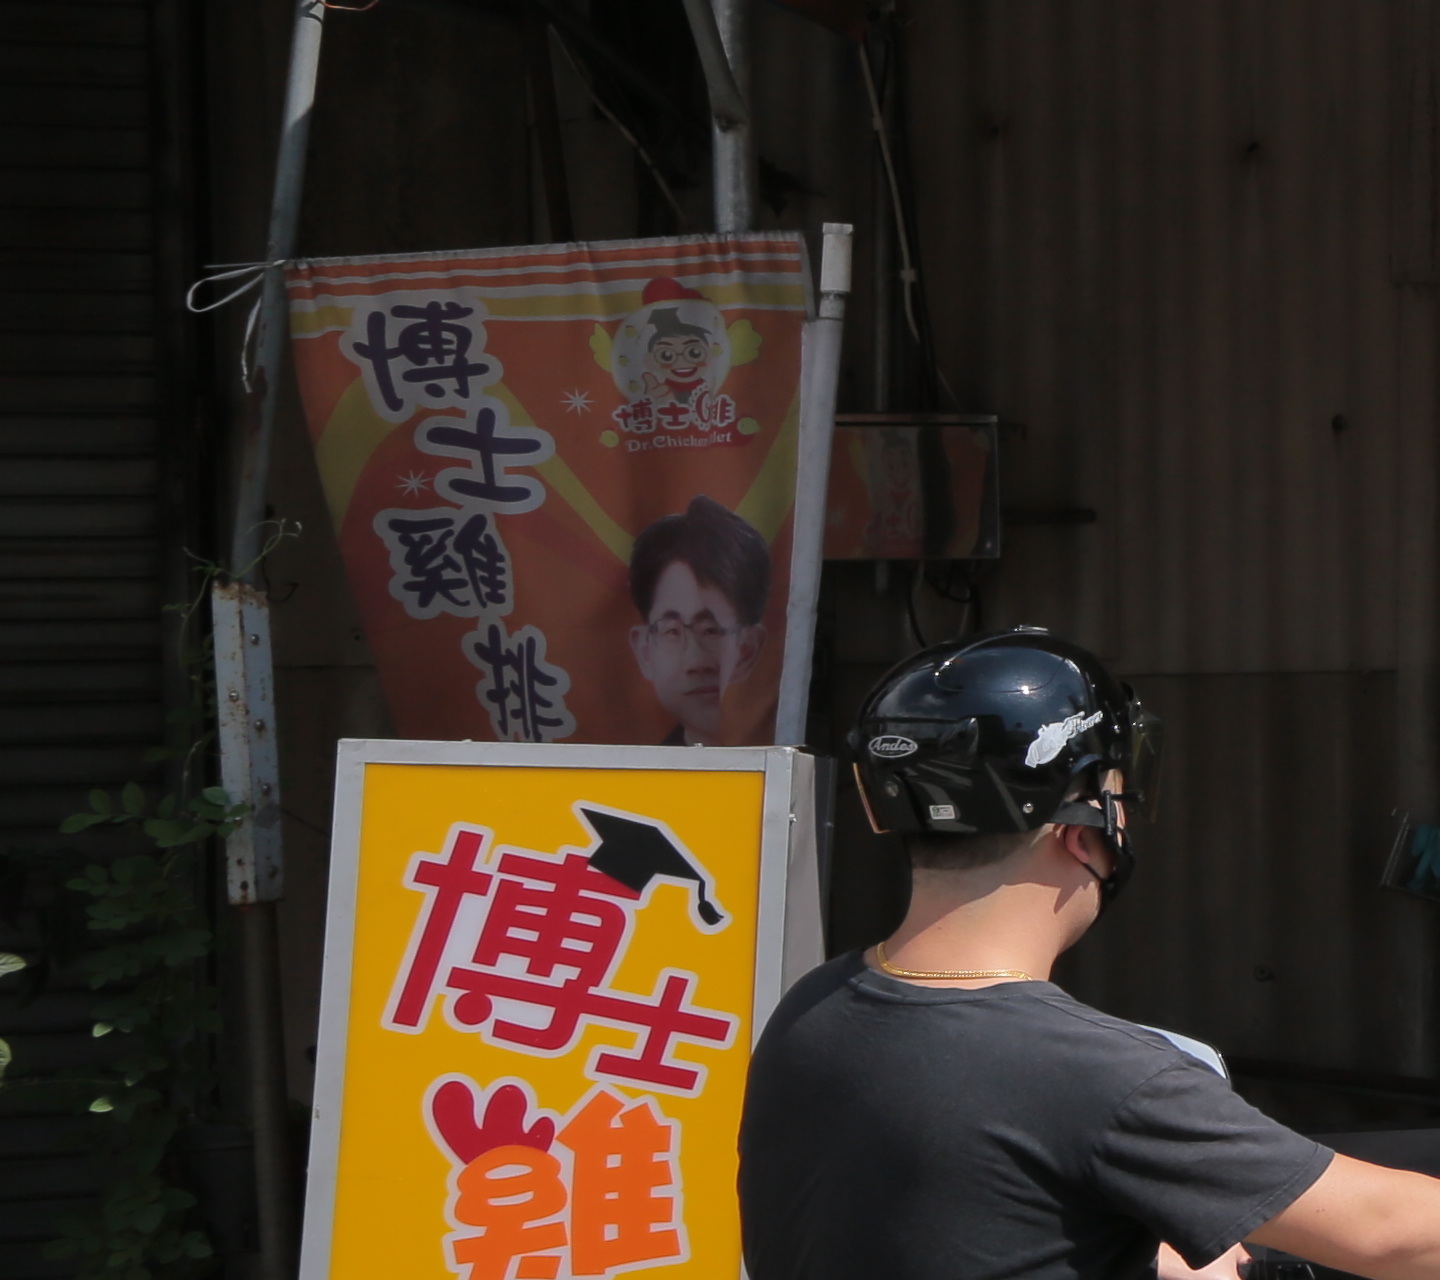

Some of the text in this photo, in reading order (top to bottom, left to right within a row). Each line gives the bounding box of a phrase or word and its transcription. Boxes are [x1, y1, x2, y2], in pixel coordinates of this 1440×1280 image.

[353, 300, 563, 741] 博士雞排
[871, 737, 916, 754] Andes
